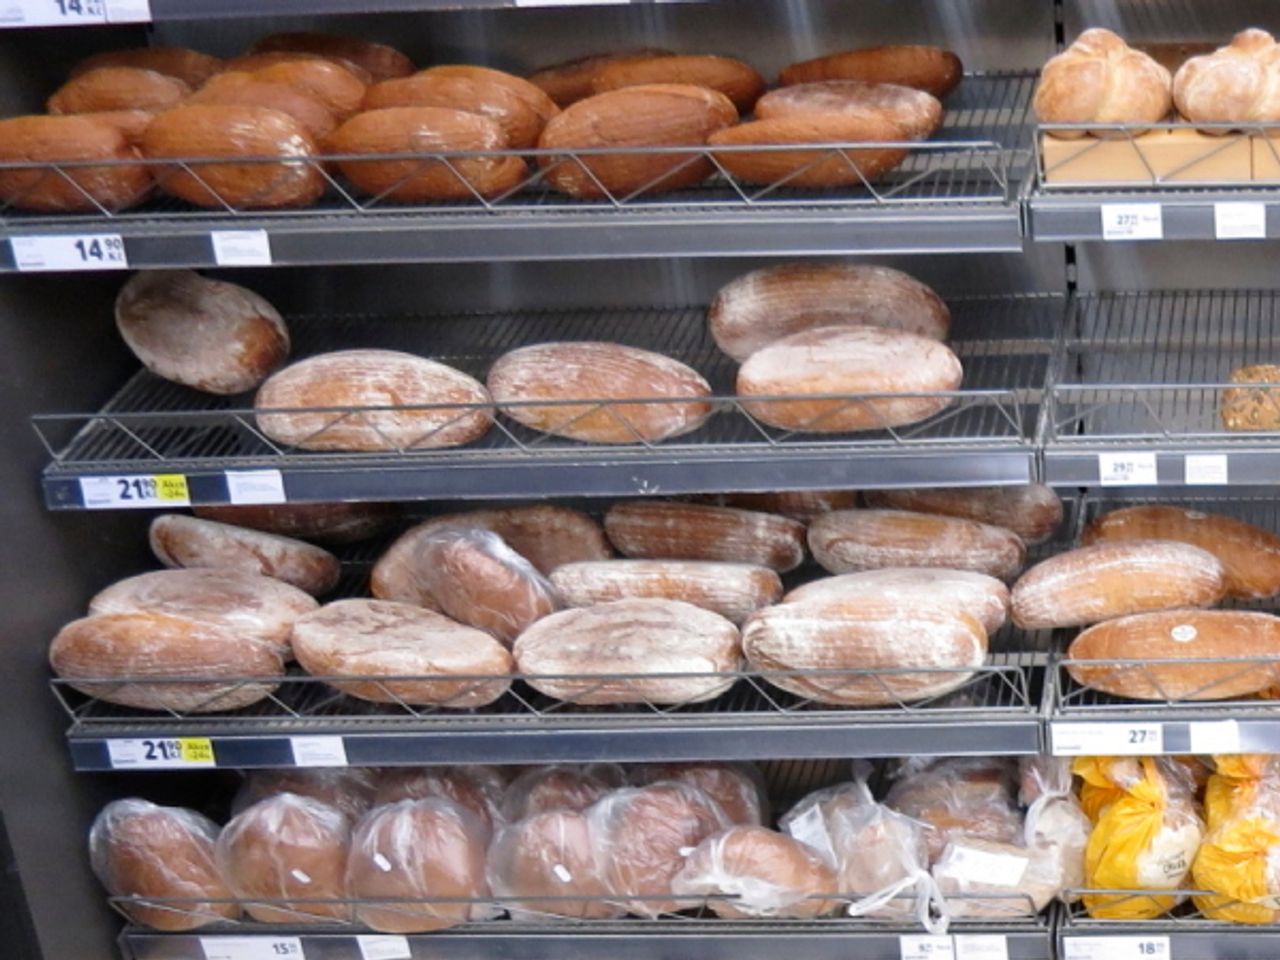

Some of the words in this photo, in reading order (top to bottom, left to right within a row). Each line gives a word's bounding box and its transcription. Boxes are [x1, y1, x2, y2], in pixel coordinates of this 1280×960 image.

[75, 239, 104, 261] 14
[117, 479, 145, 500] 21
[1129, 730, 1147, 743] 27
[142, 741, 168, 760] 21
[272, 943, 289, 954] 15
[1138, 943, 1155, 954] 18
